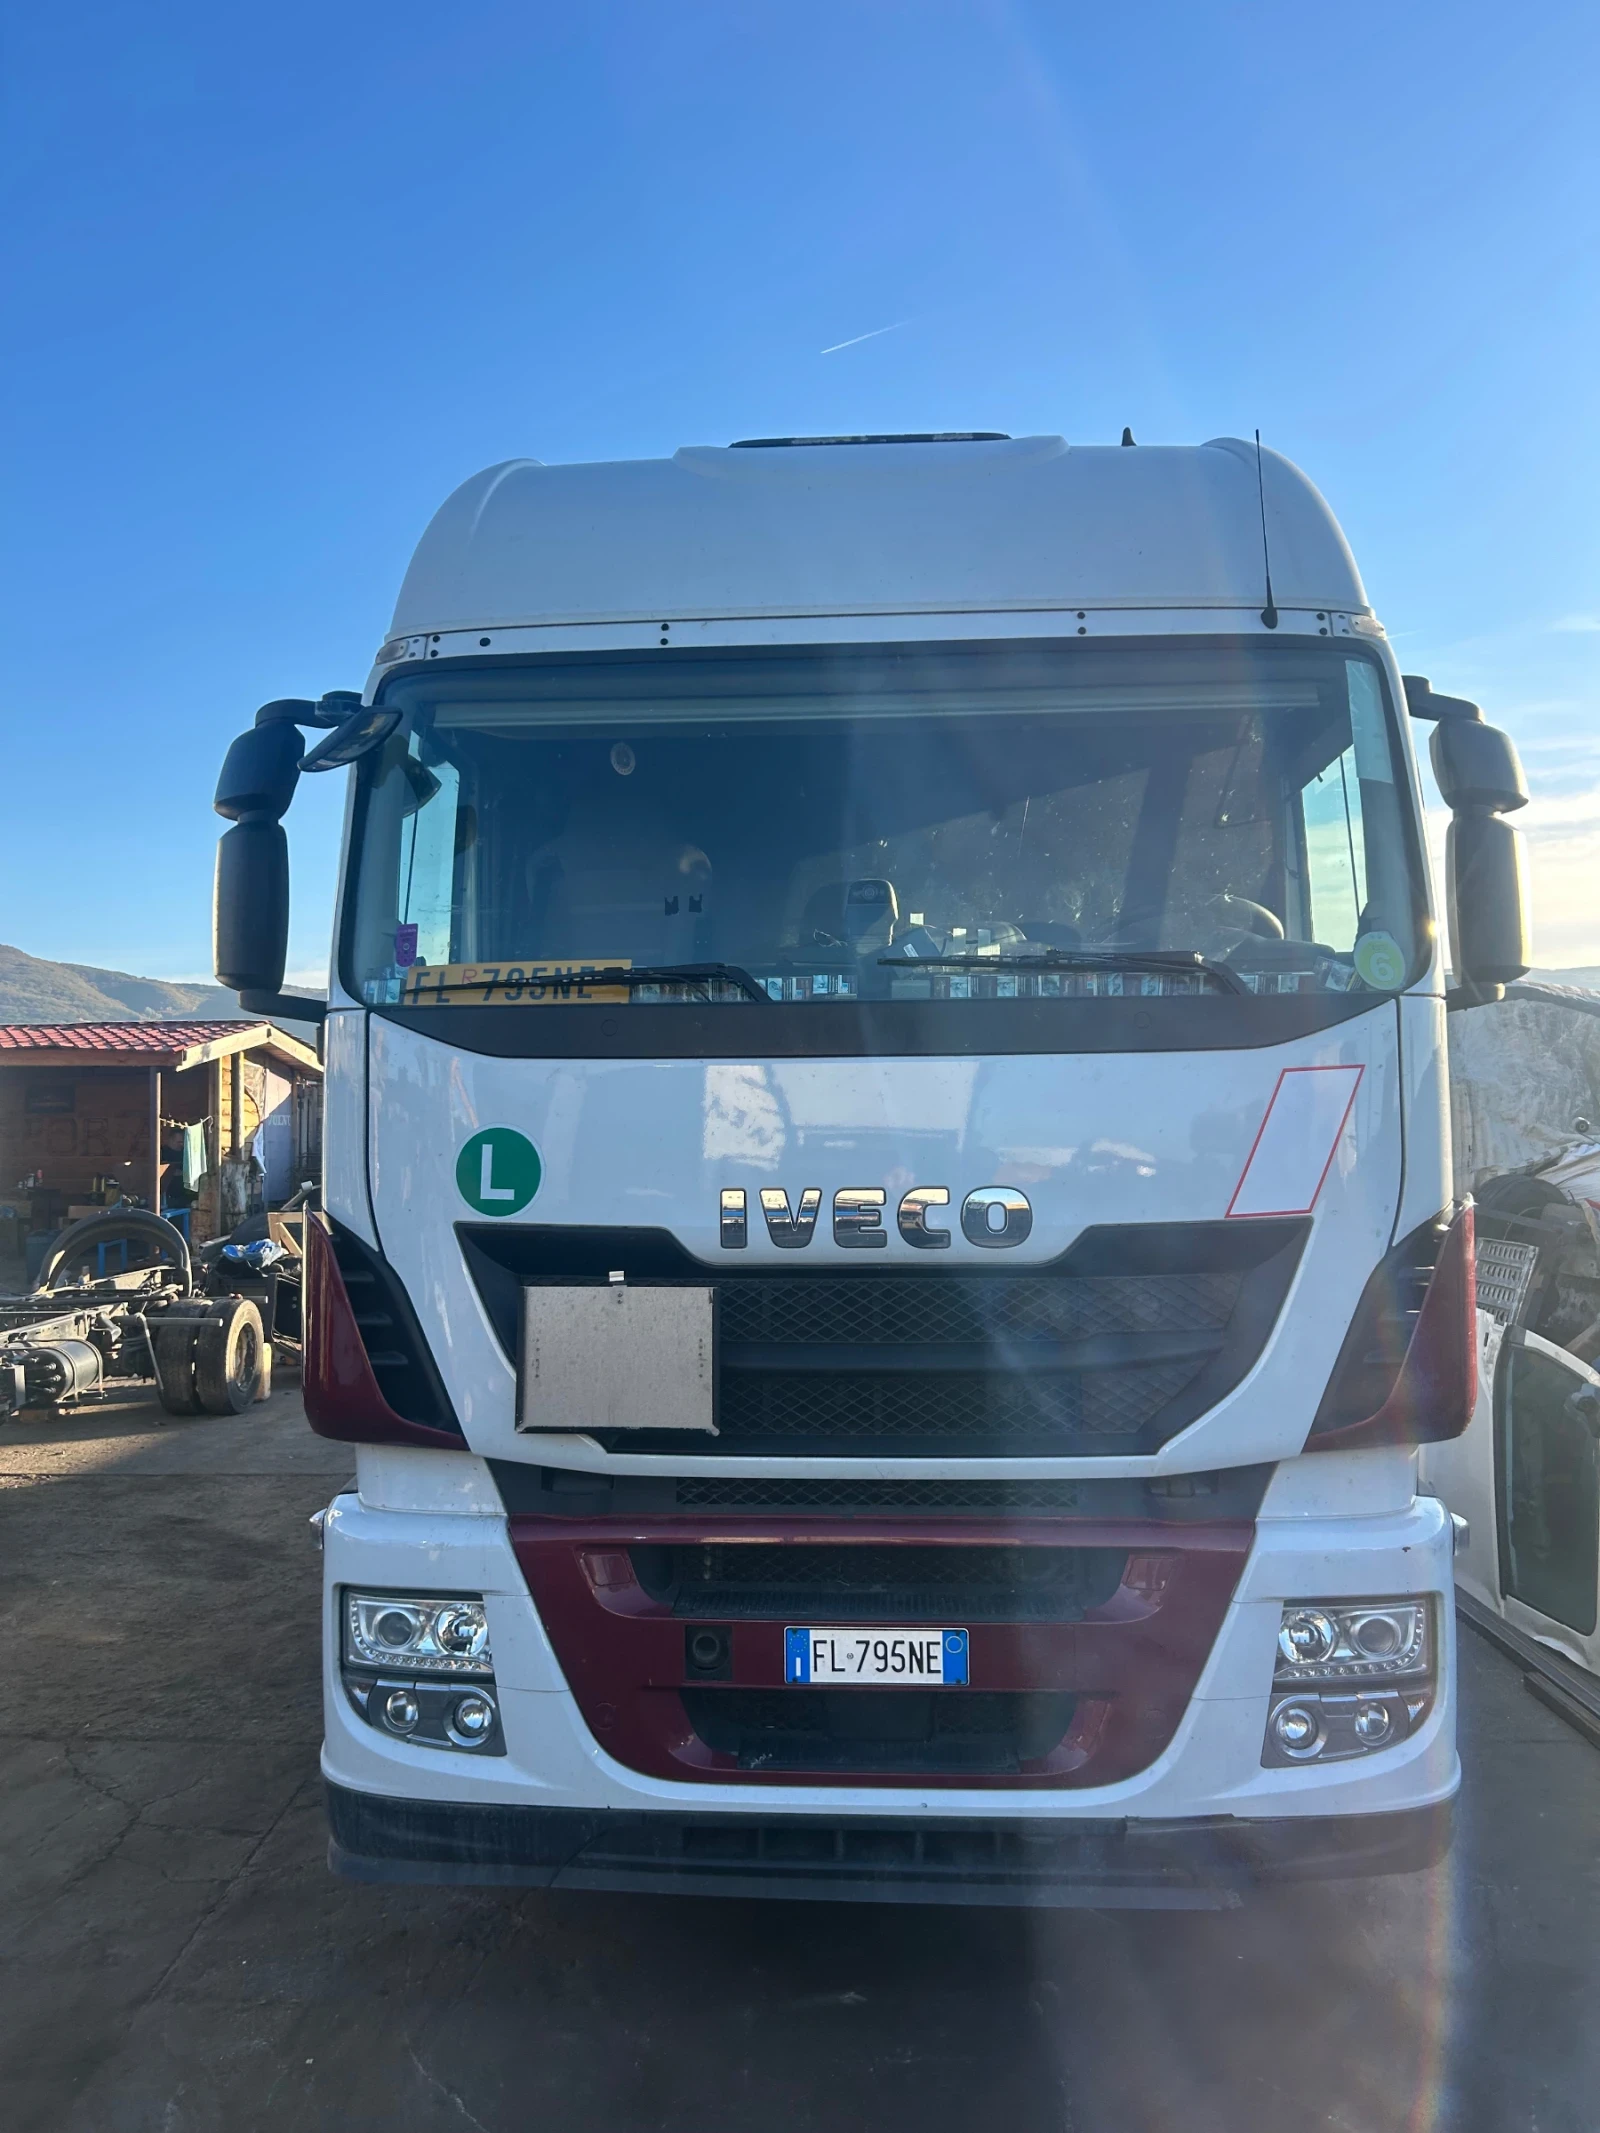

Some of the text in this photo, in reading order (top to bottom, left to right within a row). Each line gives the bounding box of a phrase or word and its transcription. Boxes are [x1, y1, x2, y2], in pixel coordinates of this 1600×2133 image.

[1370, 952, 1394, 982] 6
[480, 1143, 516, 1200] L
[718, 1186, 1033, 1249] IVECO
[812, 1639, 942, 1674] FL 795NE
